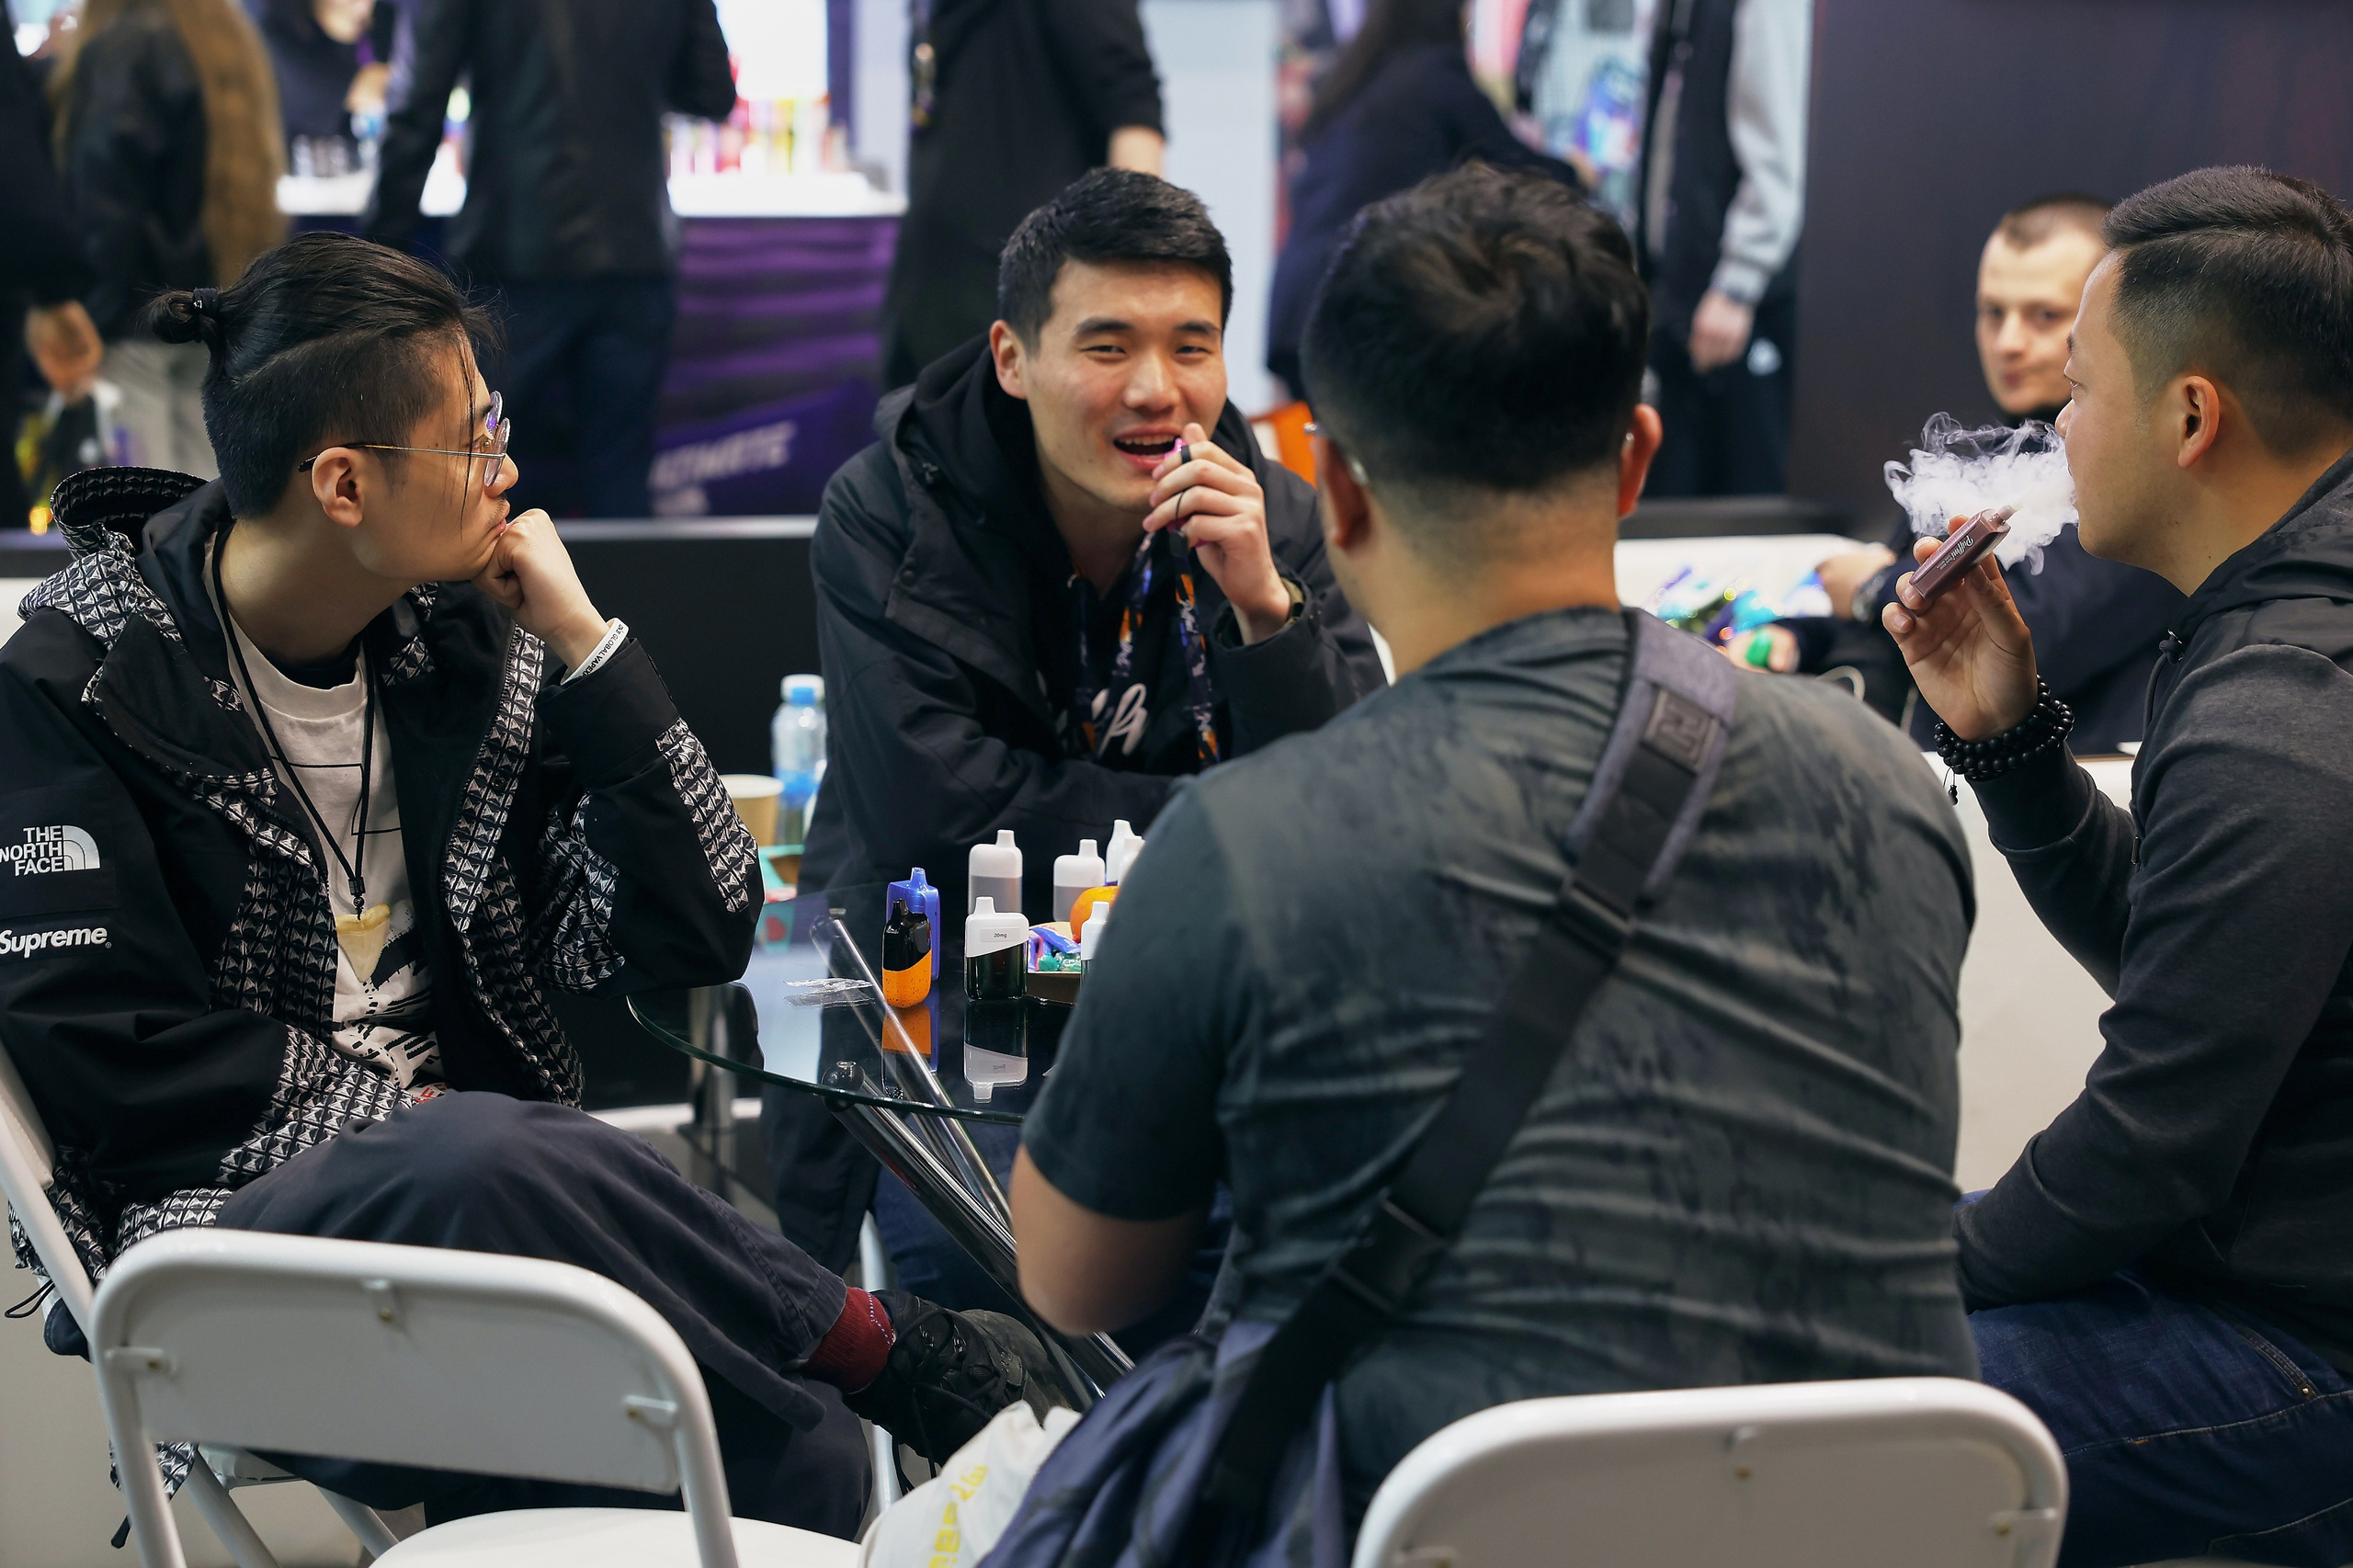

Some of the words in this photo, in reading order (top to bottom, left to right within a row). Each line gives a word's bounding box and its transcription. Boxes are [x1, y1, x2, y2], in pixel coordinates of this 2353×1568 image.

[23, 825, 63, 843] THE
[0, 841, 63, 862] NORTH
[15, 856, 63, 876] FACE
[0, 927, 108, 959] Supreme
